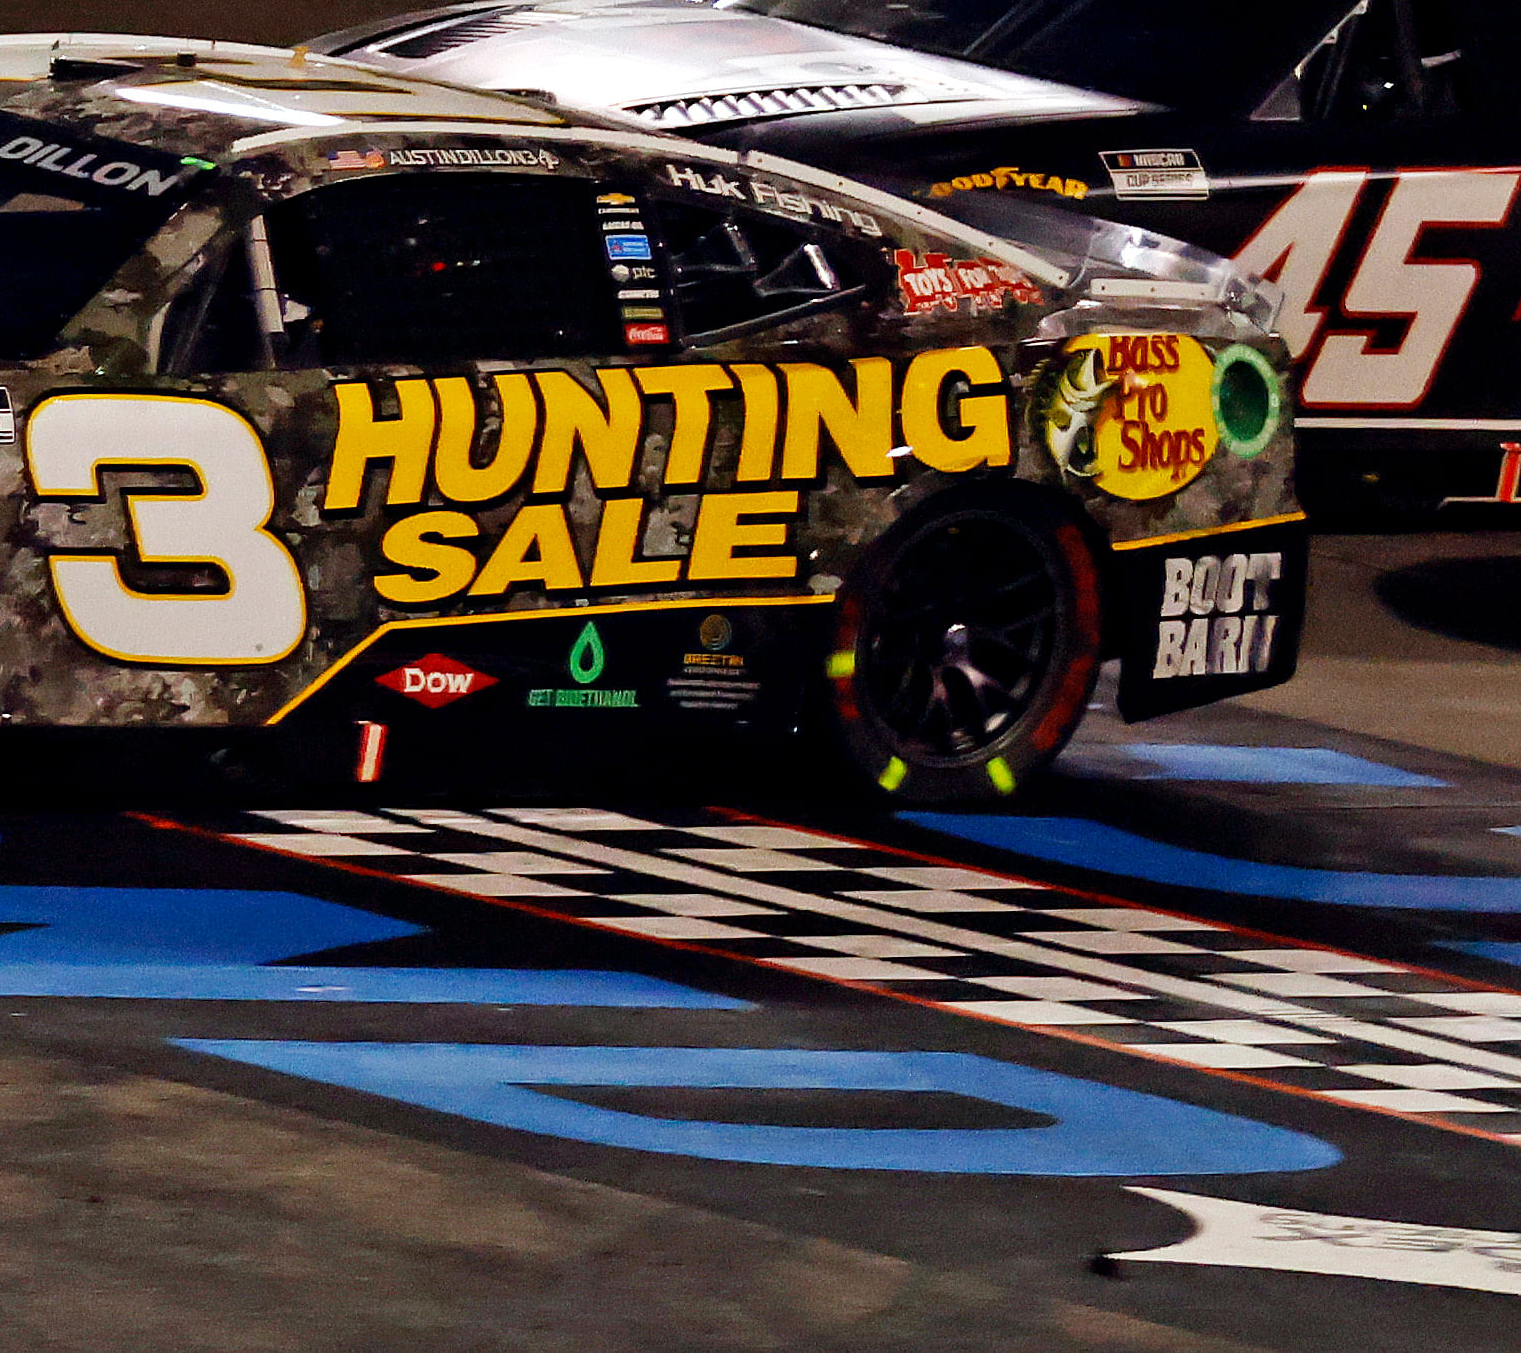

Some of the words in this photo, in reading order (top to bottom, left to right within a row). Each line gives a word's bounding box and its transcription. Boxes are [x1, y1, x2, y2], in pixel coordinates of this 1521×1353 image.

[665, 164, 746, 200] Huk
[750, 181, 884, 237] Fishing
[903, 268, 954, 297] TOYS
[1222, 163, 1521, 411] 45
[1108, 335, 1180, 375] Bass
[322, 345, 1012, 512] HUNTING
[1113, 382, 1169, 422] Pro
[1118, 420, 1206, 481] Shops
[25, 391, 307, 664] 3
[372, 489, 798, 603] SALE
[1160, 552, 1282, 617] BOOT
[1152, 615, 1280, 680] BARN
